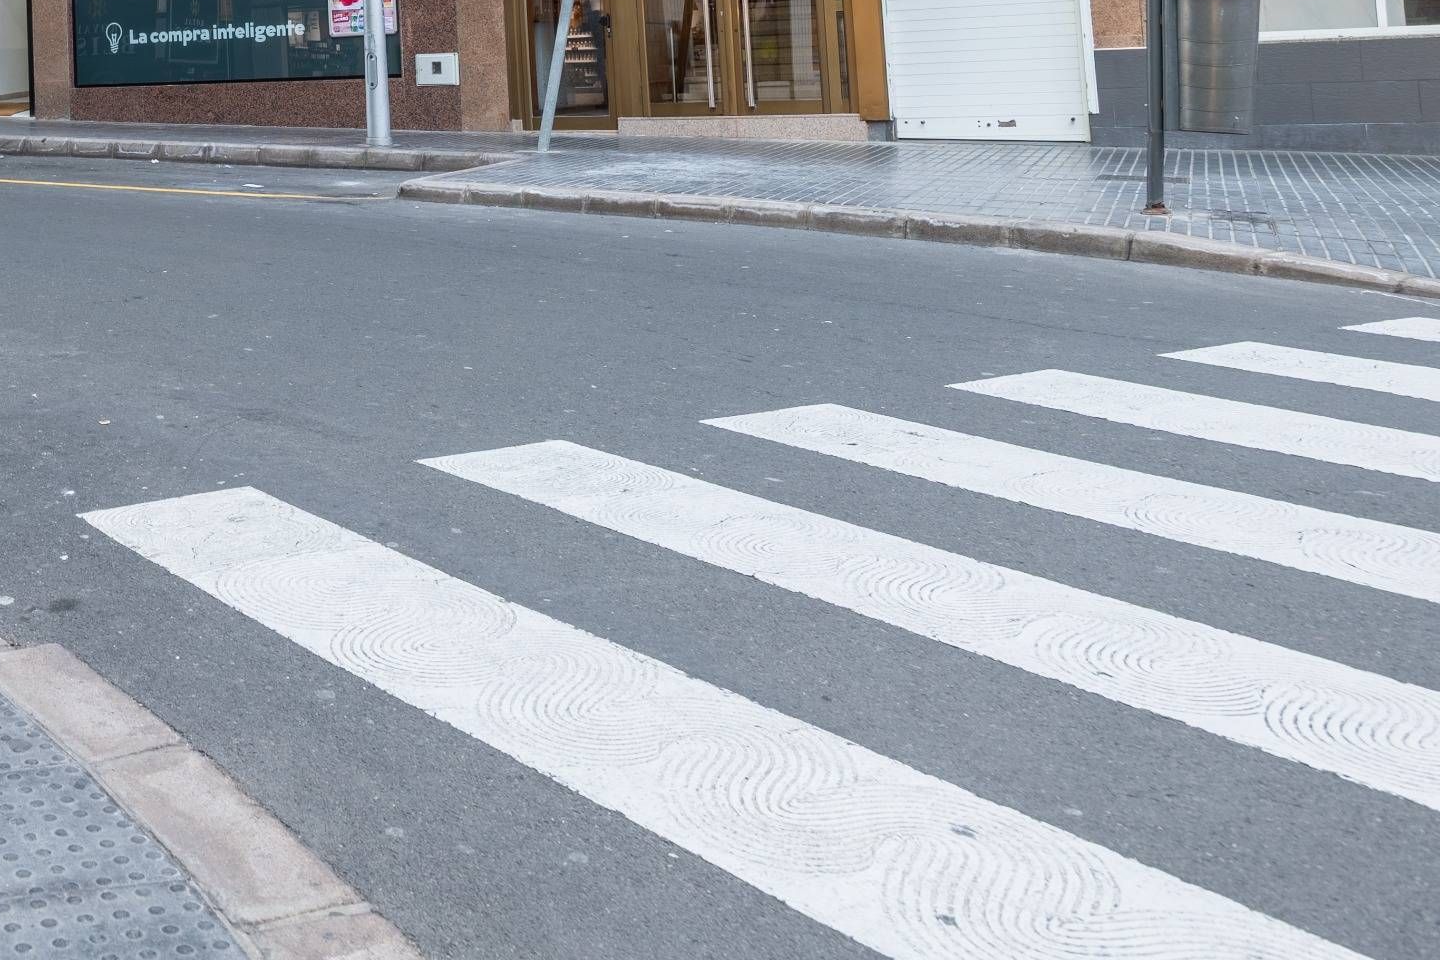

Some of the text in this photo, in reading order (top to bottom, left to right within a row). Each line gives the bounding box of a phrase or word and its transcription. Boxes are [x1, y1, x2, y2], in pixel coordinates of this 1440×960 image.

[129, 20, 306, 47] La compra inteligente
